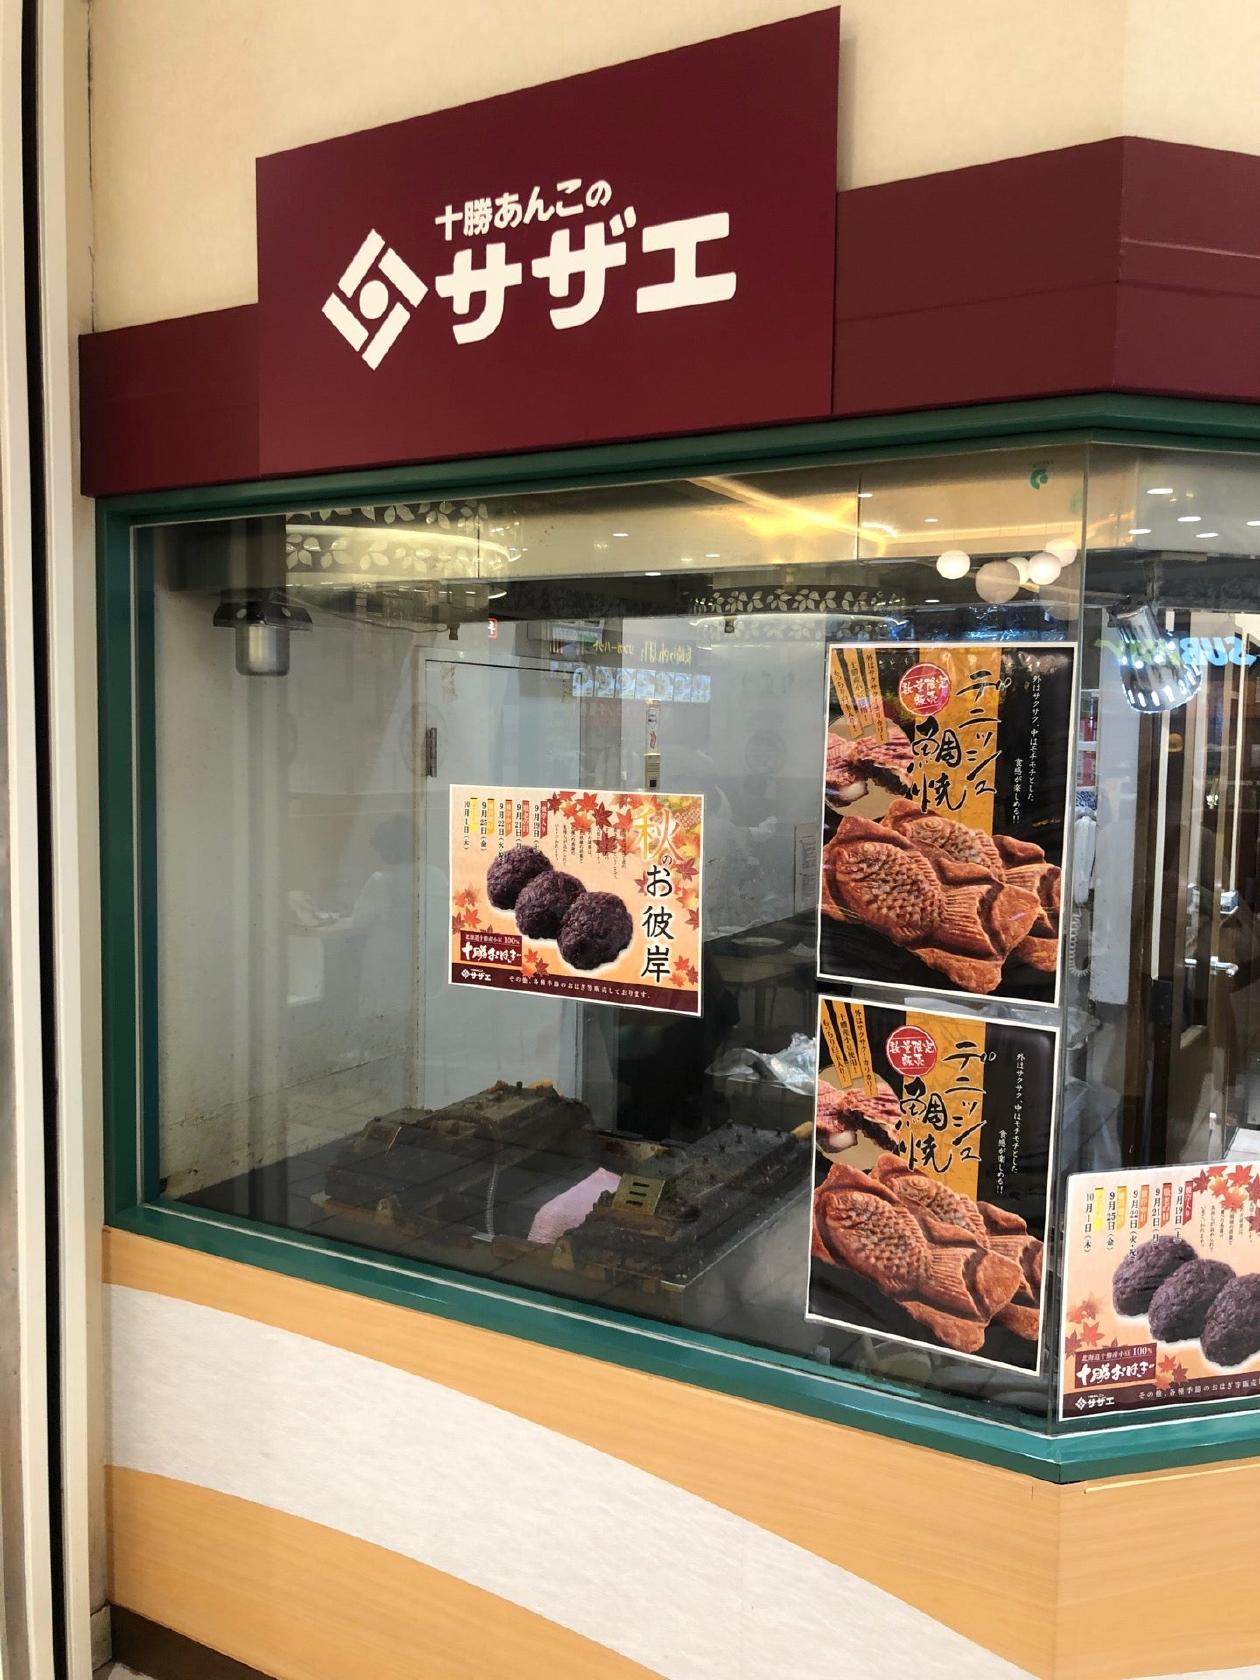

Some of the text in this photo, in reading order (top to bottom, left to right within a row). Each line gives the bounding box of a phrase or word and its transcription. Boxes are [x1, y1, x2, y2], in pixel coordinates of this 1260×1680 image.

[434, 177, 613, 241] 十勝あんこの
[434, 205, 737, 345] サザエ
[903, 714, 967, 813] 鯛焼
[632, 806, 683, 984] 秋のお彼岸
[461, 941, 522, 964] 十勝おはぎ
[470, 972, 492, 982] サザエ
[893, 1075, 953, 1174] 鯛焼
[1083, 1192, 1095, 1253] 10月1日(木)
[1106, 1191, 1116, 1250] 9月25日(金)
[1075, 1360, 1155, 1386] 十勝おはぎ
[1132, 1346, 1153, 1356] 100%
[1087, 1396, 1115, 1409] サザエ
[1138, 1378, 1260, 1400] その他、各種季節のおはぎ等販売
